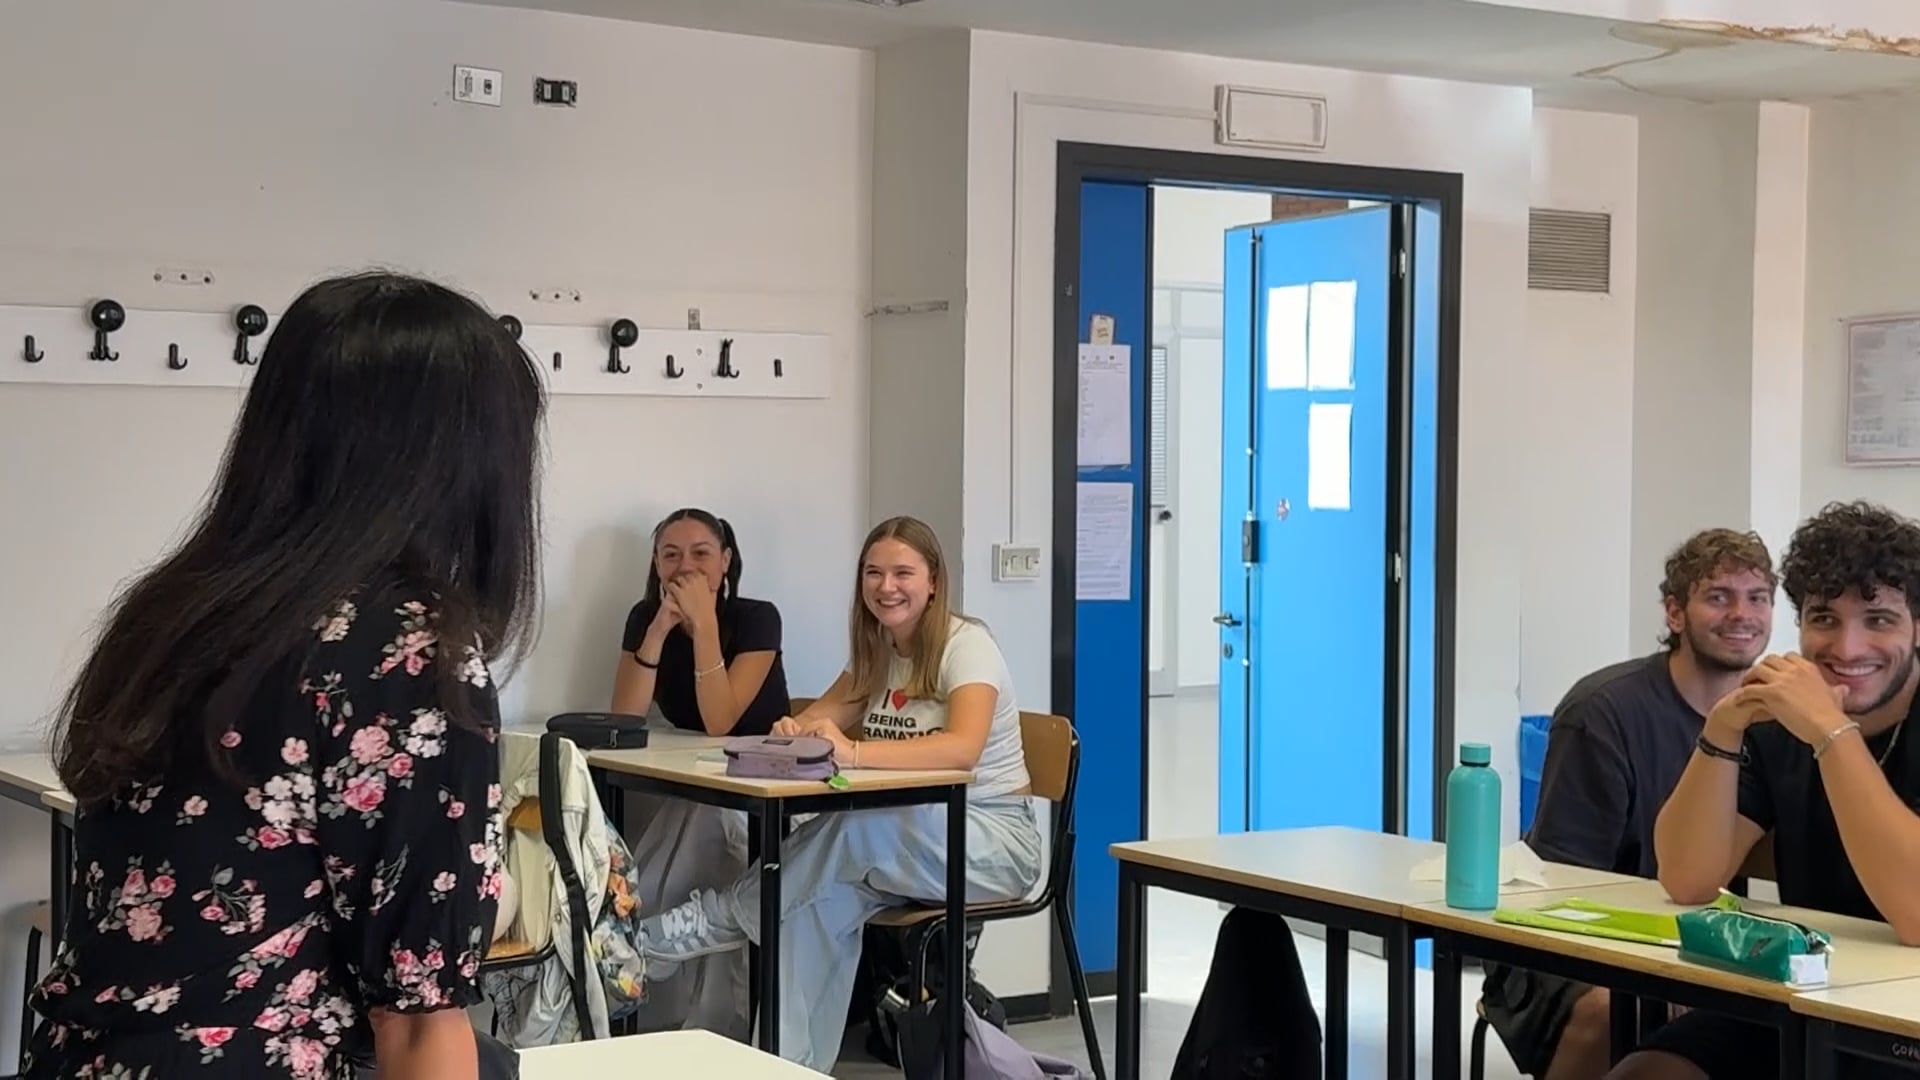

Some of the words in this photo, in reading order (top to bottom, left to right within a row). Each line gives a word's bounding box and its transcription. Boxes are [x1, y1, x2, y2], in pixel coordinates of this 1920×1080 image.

[882, 689, 891, 709] I
[868, 713, 917, 728] BEING
[864, 727, 943, 740] RAMAT
